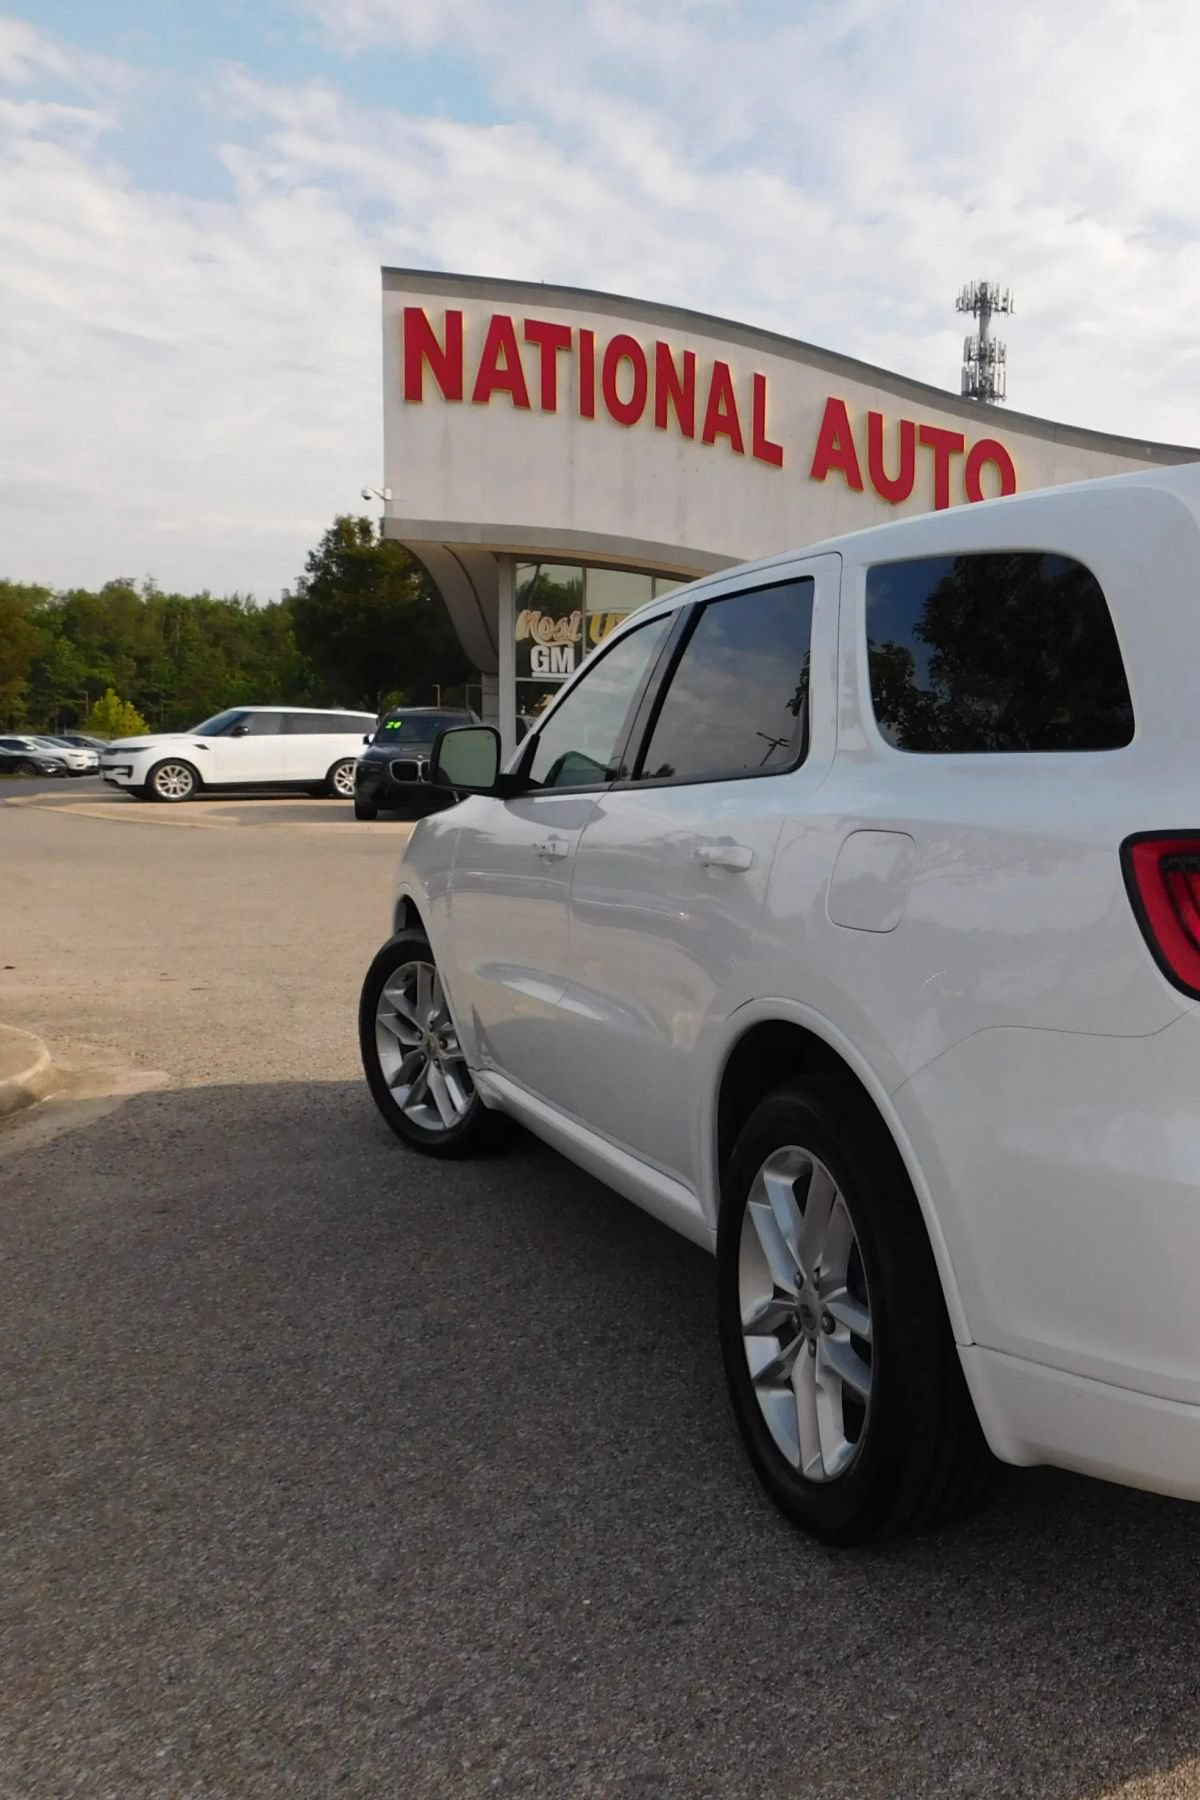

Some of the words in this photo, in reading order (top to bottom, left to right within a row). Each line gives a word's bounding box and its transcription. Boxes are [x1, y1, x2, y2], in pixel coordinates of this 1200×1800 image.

[403, 306, 784, 468] NATIONAL
[809, 396, 1017, 512] AUTO
[530, 645, 575, 673] GM
